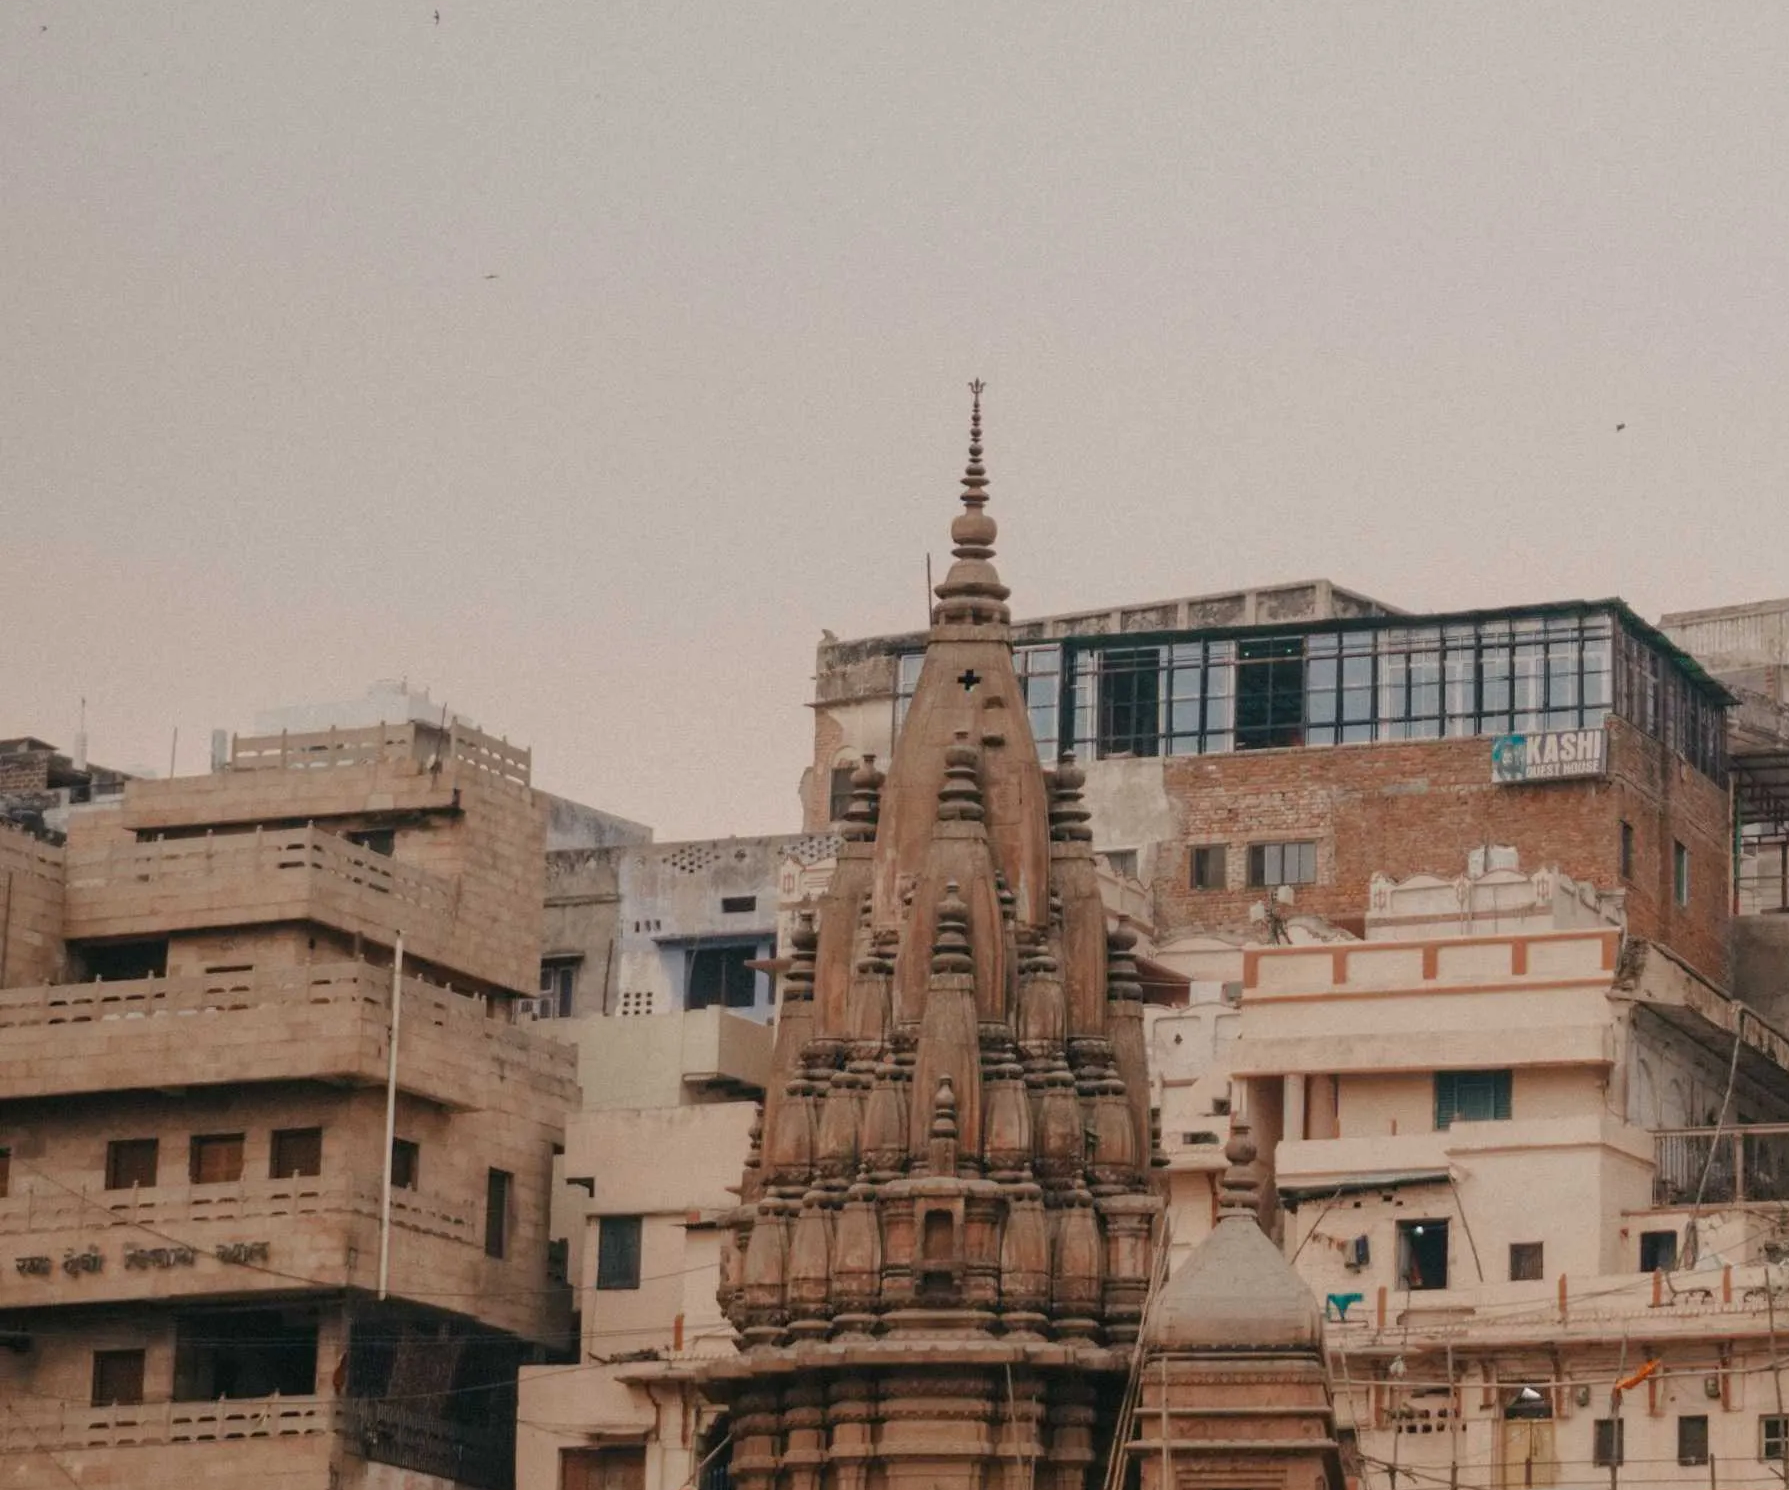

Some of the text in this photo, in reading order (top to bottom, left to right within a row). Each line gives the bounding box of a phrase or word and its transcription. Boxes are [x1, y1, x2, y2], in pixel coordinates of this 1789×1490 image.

[1526, 730, 1601, 766] KASHI
[1526, 760, 1600, 778] GUEST HOUSE
